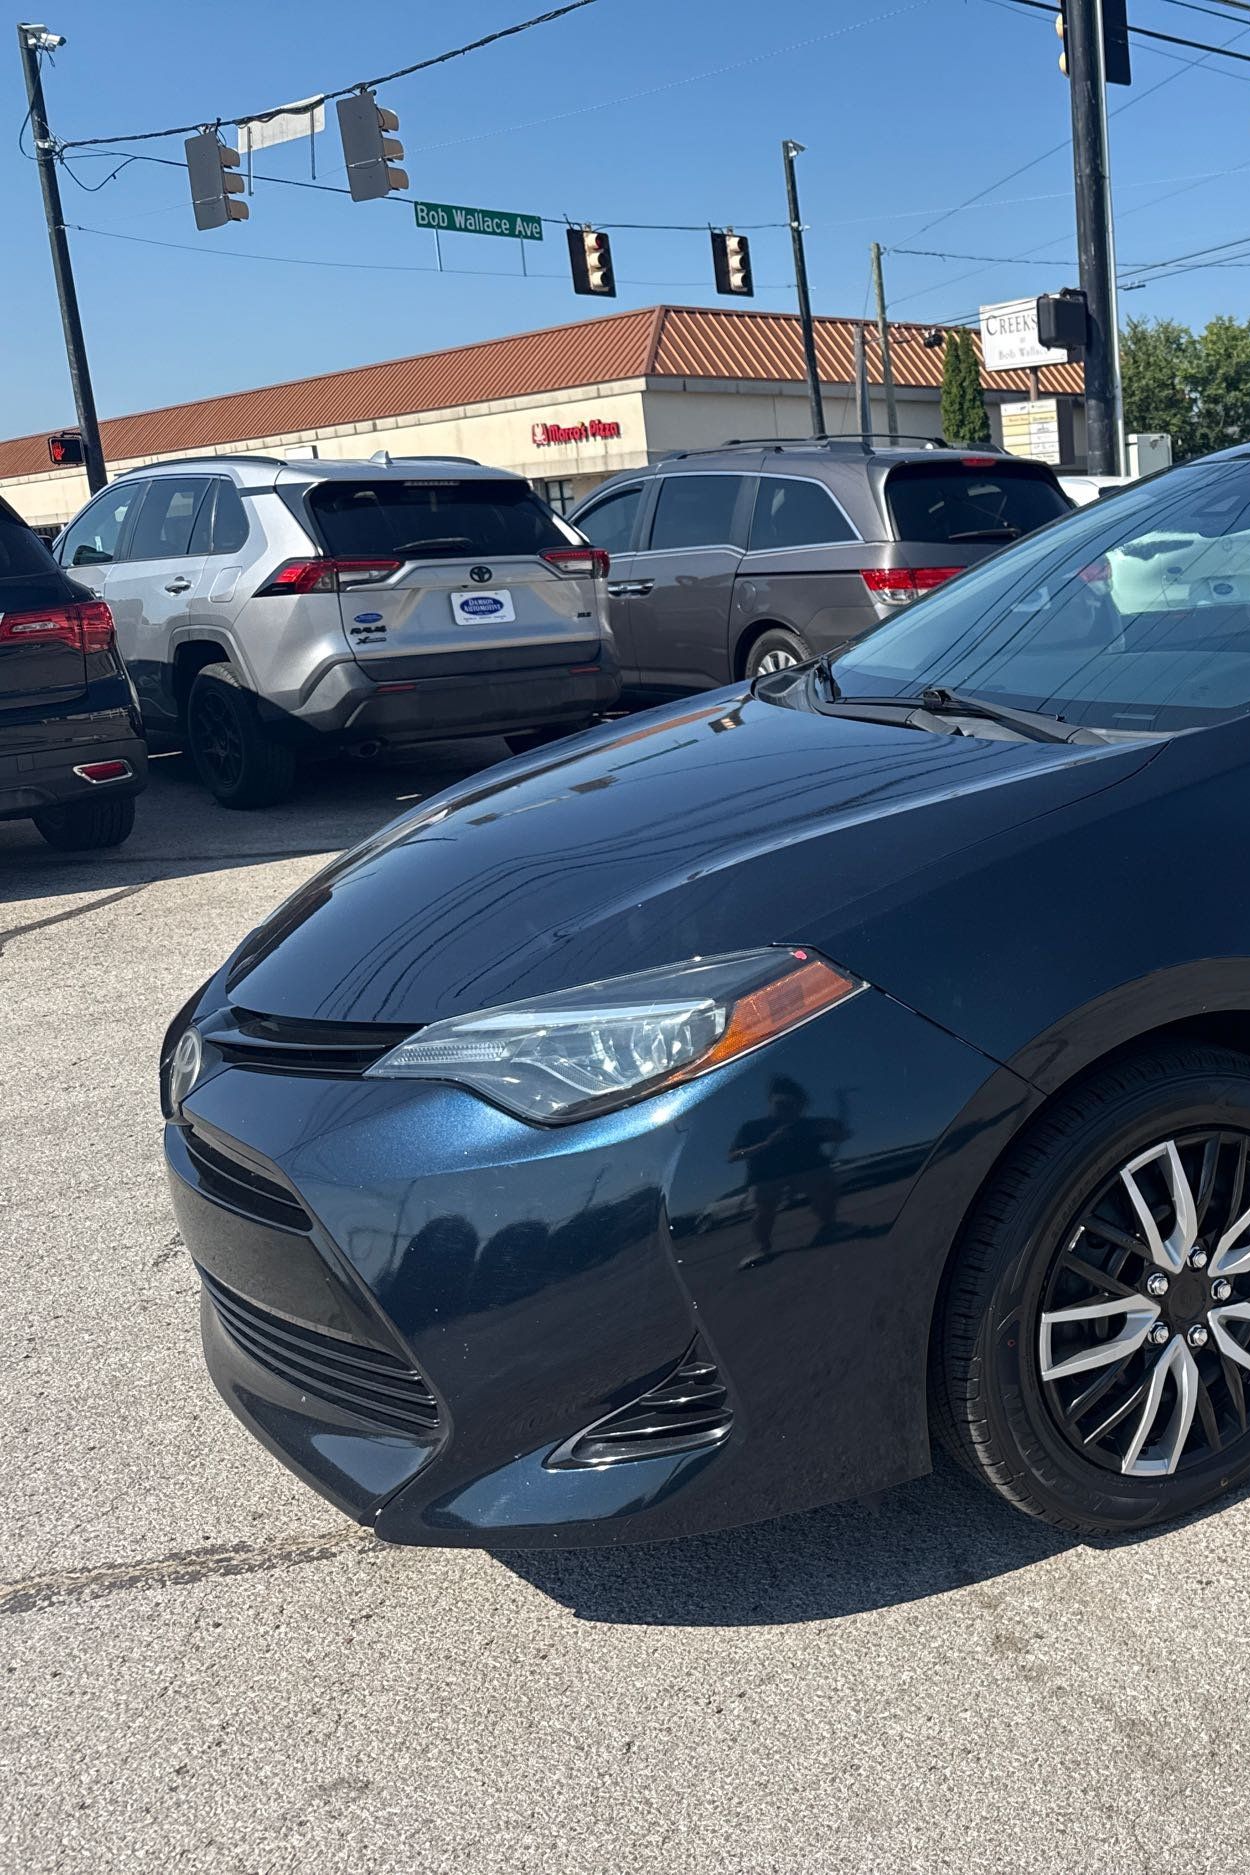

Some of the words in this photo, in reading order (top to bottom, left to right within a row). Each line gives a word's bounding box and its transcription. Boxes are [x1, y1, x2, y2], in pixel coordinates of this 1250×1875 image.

[416, 205, 448, 227] Bob
[452, 209, 510, 234] Wallace
[515, 217, 541, 237] Ave
[986, 314, 1038, 336] CREEKS
[548, 421, 588, 443] Marco's
[589, 419, 621, 440] Pizza
